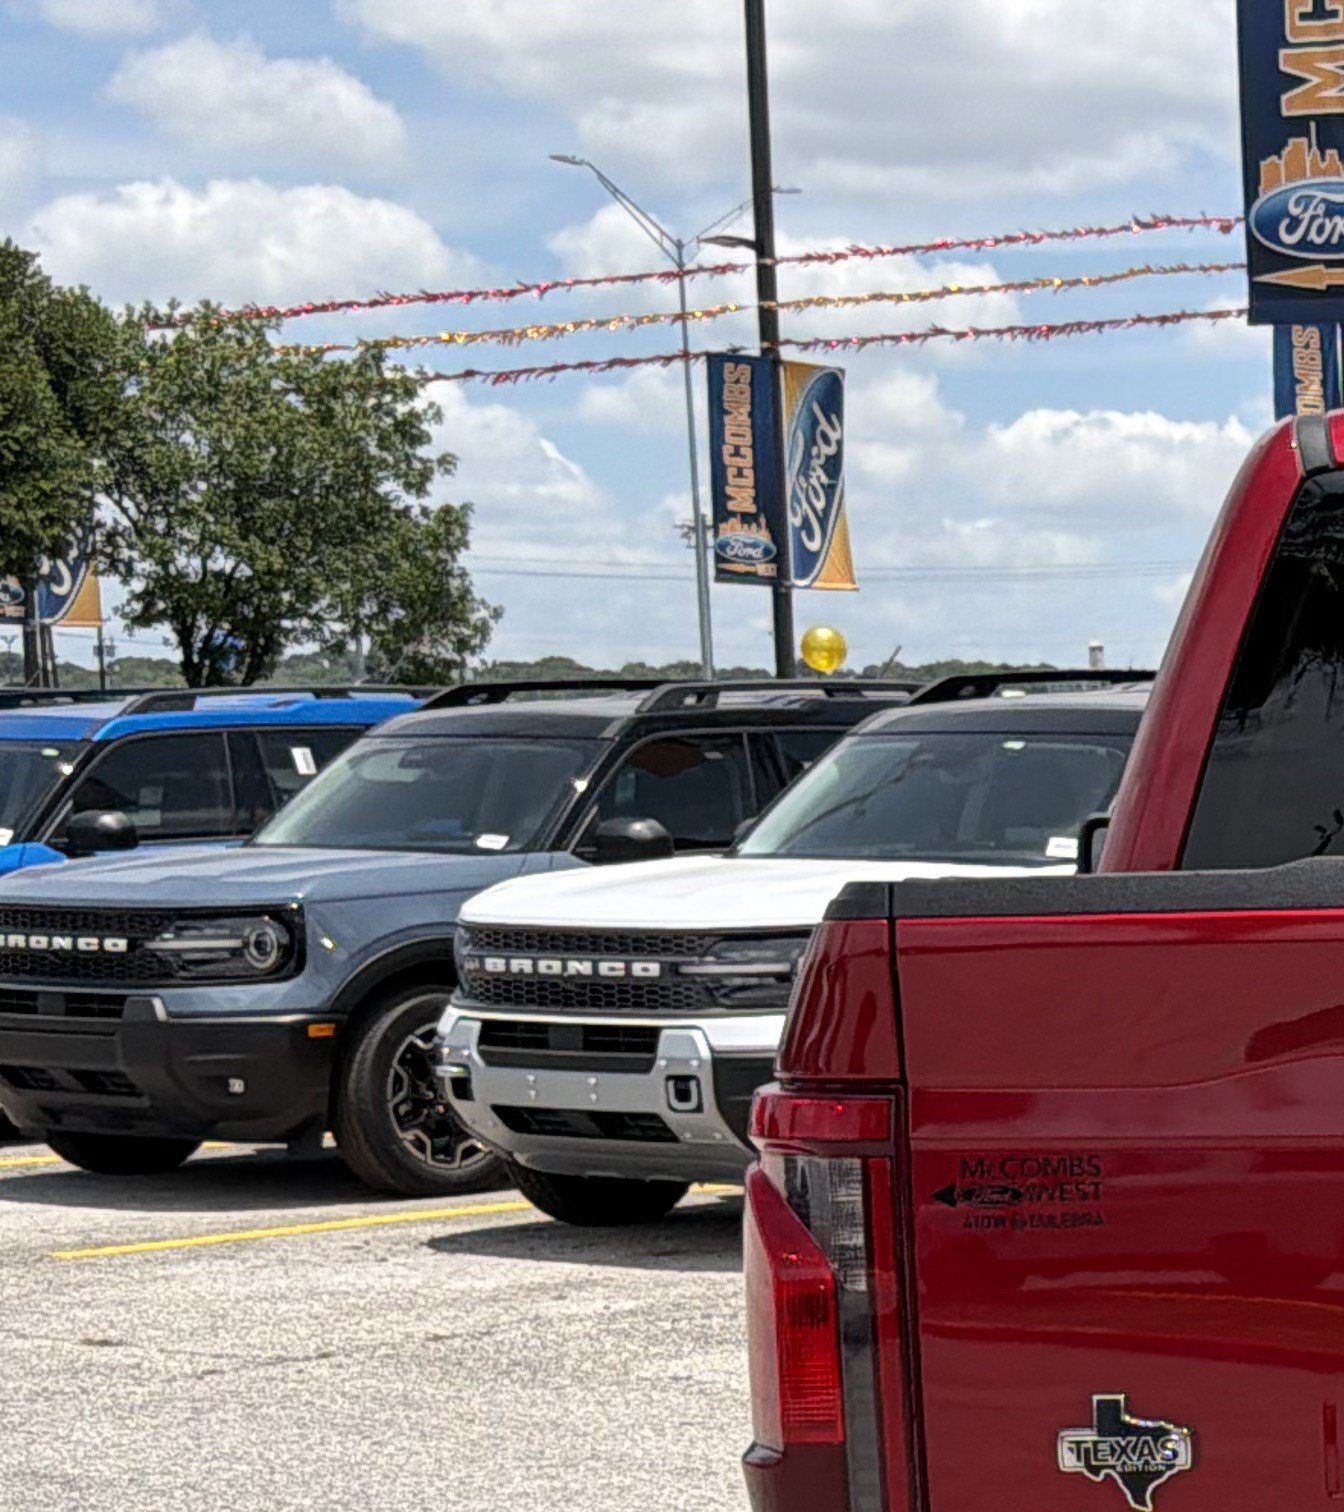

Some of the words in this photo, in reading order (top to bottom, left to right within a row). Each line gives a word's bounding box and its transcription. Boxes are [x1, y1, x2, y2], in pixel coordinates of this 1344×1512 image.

[722, 362, 758, 514] MCCOMBS
[790, 401, 842, 552] Ford
[0, 934, 128, 952] RONCO
[484, 957, 660, 977] BRONCO
[1068, 1435, 1180, 1466] TEXAS
